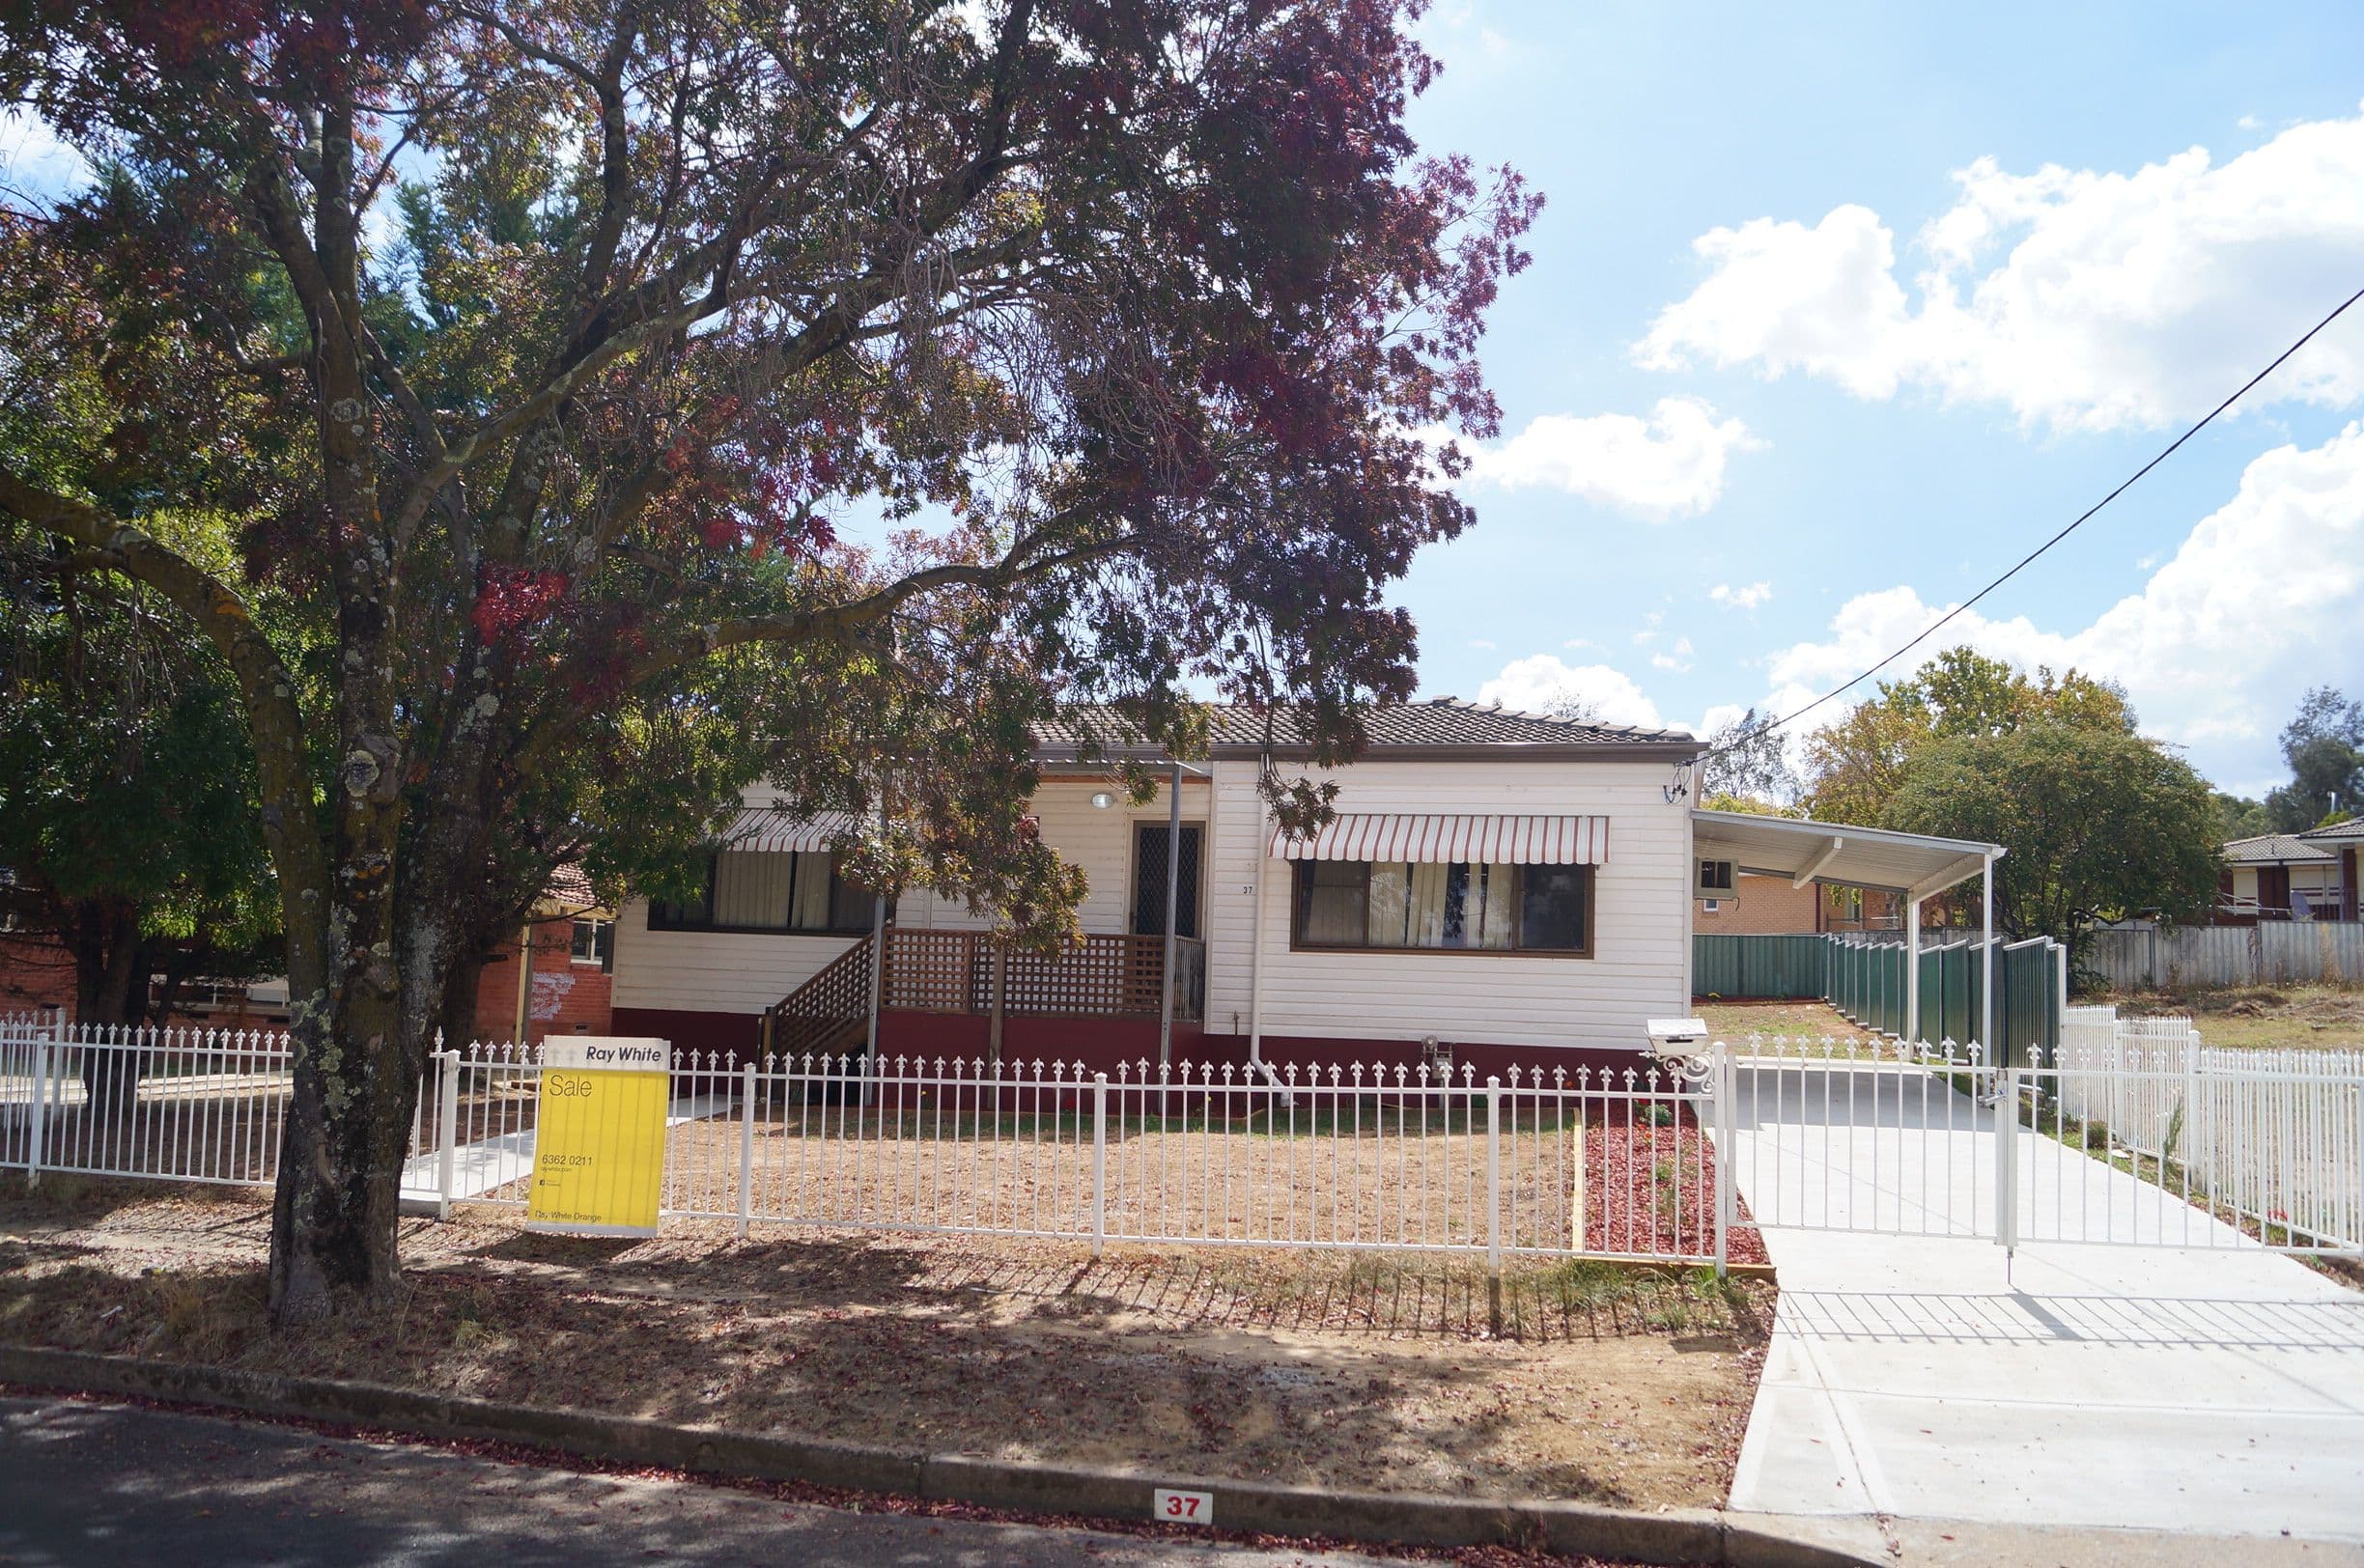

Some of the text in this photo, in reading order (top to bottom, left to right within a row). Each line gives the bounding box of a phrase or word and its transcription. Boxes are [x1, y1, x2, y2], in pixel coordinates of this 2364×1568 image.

[586, 1047, 661, 1062] Ray White
[549, 1075, 592, 1097] Sale
[542, 1154, 592, 1166] 6362 0211
[551, 1211, 572, 1219] White
[574, 1212, 602, 1222] Orange
[1167, 1496, 1200, 1517] 37
